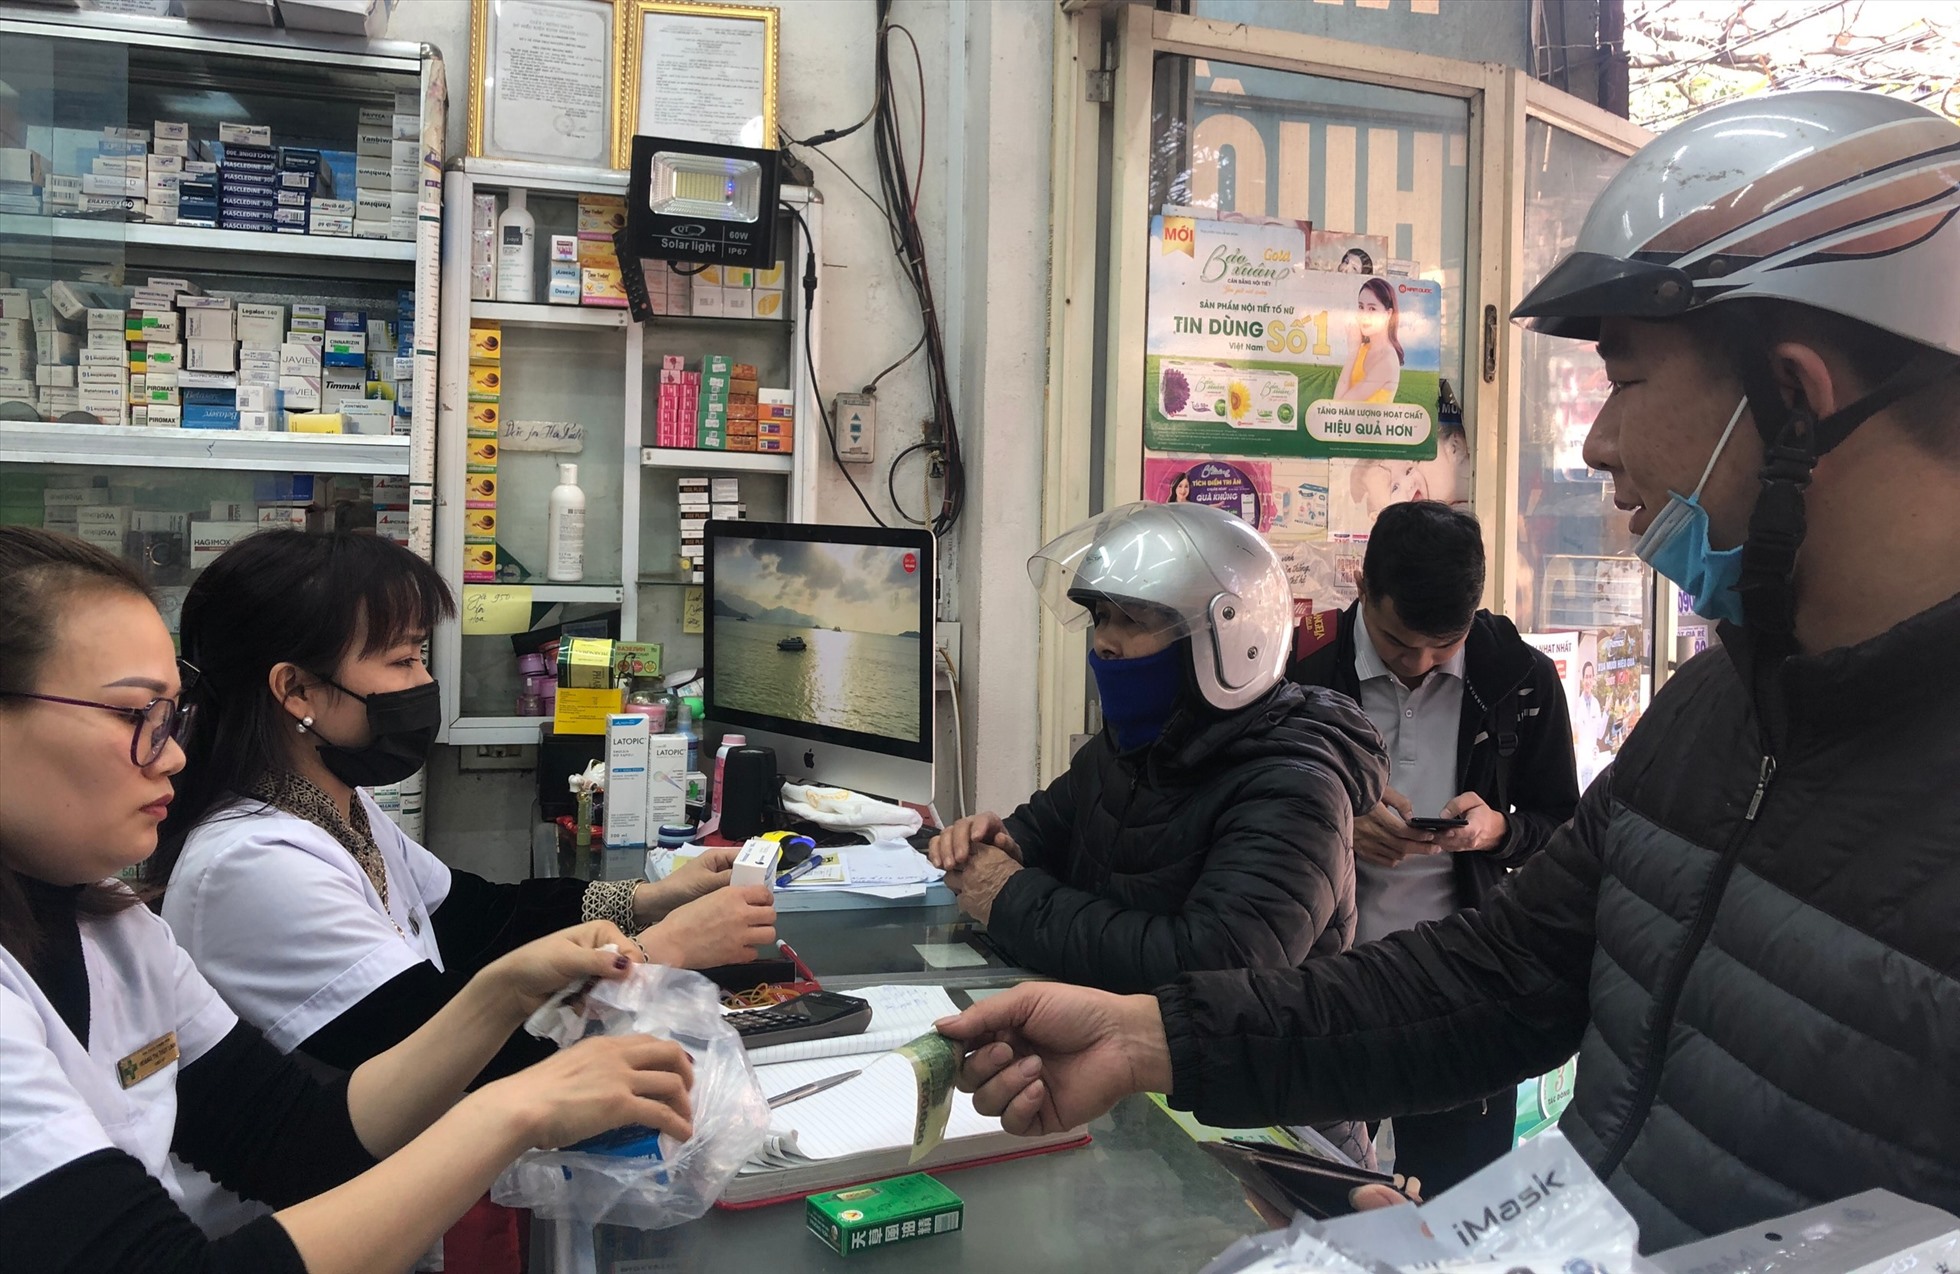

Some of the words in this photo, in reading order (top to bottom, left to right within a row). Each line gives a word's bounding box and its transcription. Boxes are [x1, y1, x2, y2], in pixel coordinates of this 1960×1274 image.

[223, 161, 260, 170] PIASCLEDINE
[224, 173, 260, 182] PIASCLEDINE
[223, 185, 260, 194] PIASCLEDINE
[222, 197, 260, 206] PIASCLEDINE
[222, 210, 260, 218] PIASCLEDINE
[222, 222, 260, 231] PIASCLEDINE
[729, 231, 749, 240] 60W
[1164, 225, 1193, 242] MỚI
[661, 238, 689, 250] Solar
[691, 239, 716, 253] light
[728, 247, 747, 256] IP67
[1264, 248, 1292, 262] Gold
[554, 288, 576, 296] Dexeryl
[1200, 299, 1215, 309] SẢN
[1217, 299, 1239, 312] PHẨM
[1241, 302, 1255, 314] NỘI
[1257, 301, 1271, 313] TIẾT
[1272, 303, 1283, 314] TỐ
[1284, 306, 1295, 315] NỮ
[1174, 316, 1202, 334] TIN
[1209, 315, 1264, 338] DÙNG
[1267, 315, 1313, 354] Số
[1312, 311, 1331, 356] 1
[1229, 341, 1244, 351] Việt
[1245, 343, 1264, 351] Nam
[282, 355, 318, 365] JAVIEL
[325, 381, 361, 391] Timmak
[1317, 406, 1337, 415] TĂNG
[1339, 407, 1355, 416] HÀM
[1357, 409, 1382, 418] LƯỢNG
[1383, 411, 1402, 420] HOẠT
[1404, 409, 1423, 419] CHẤT
[1324, 419, 1351, 437] HIỆU
[1355, 420, 1382, 436] QUẢ
[1386, 425, 1413, 437] HƠN
[1196, 492, 1212, 502] QUÀ
[1556, 642, 1572, 654] NHẤT
[613, 737, 645, 746] LATOPIC
[1554, 1064, 1566, 1092] 3
[1452, 1170, 1565, 1247] iMask
